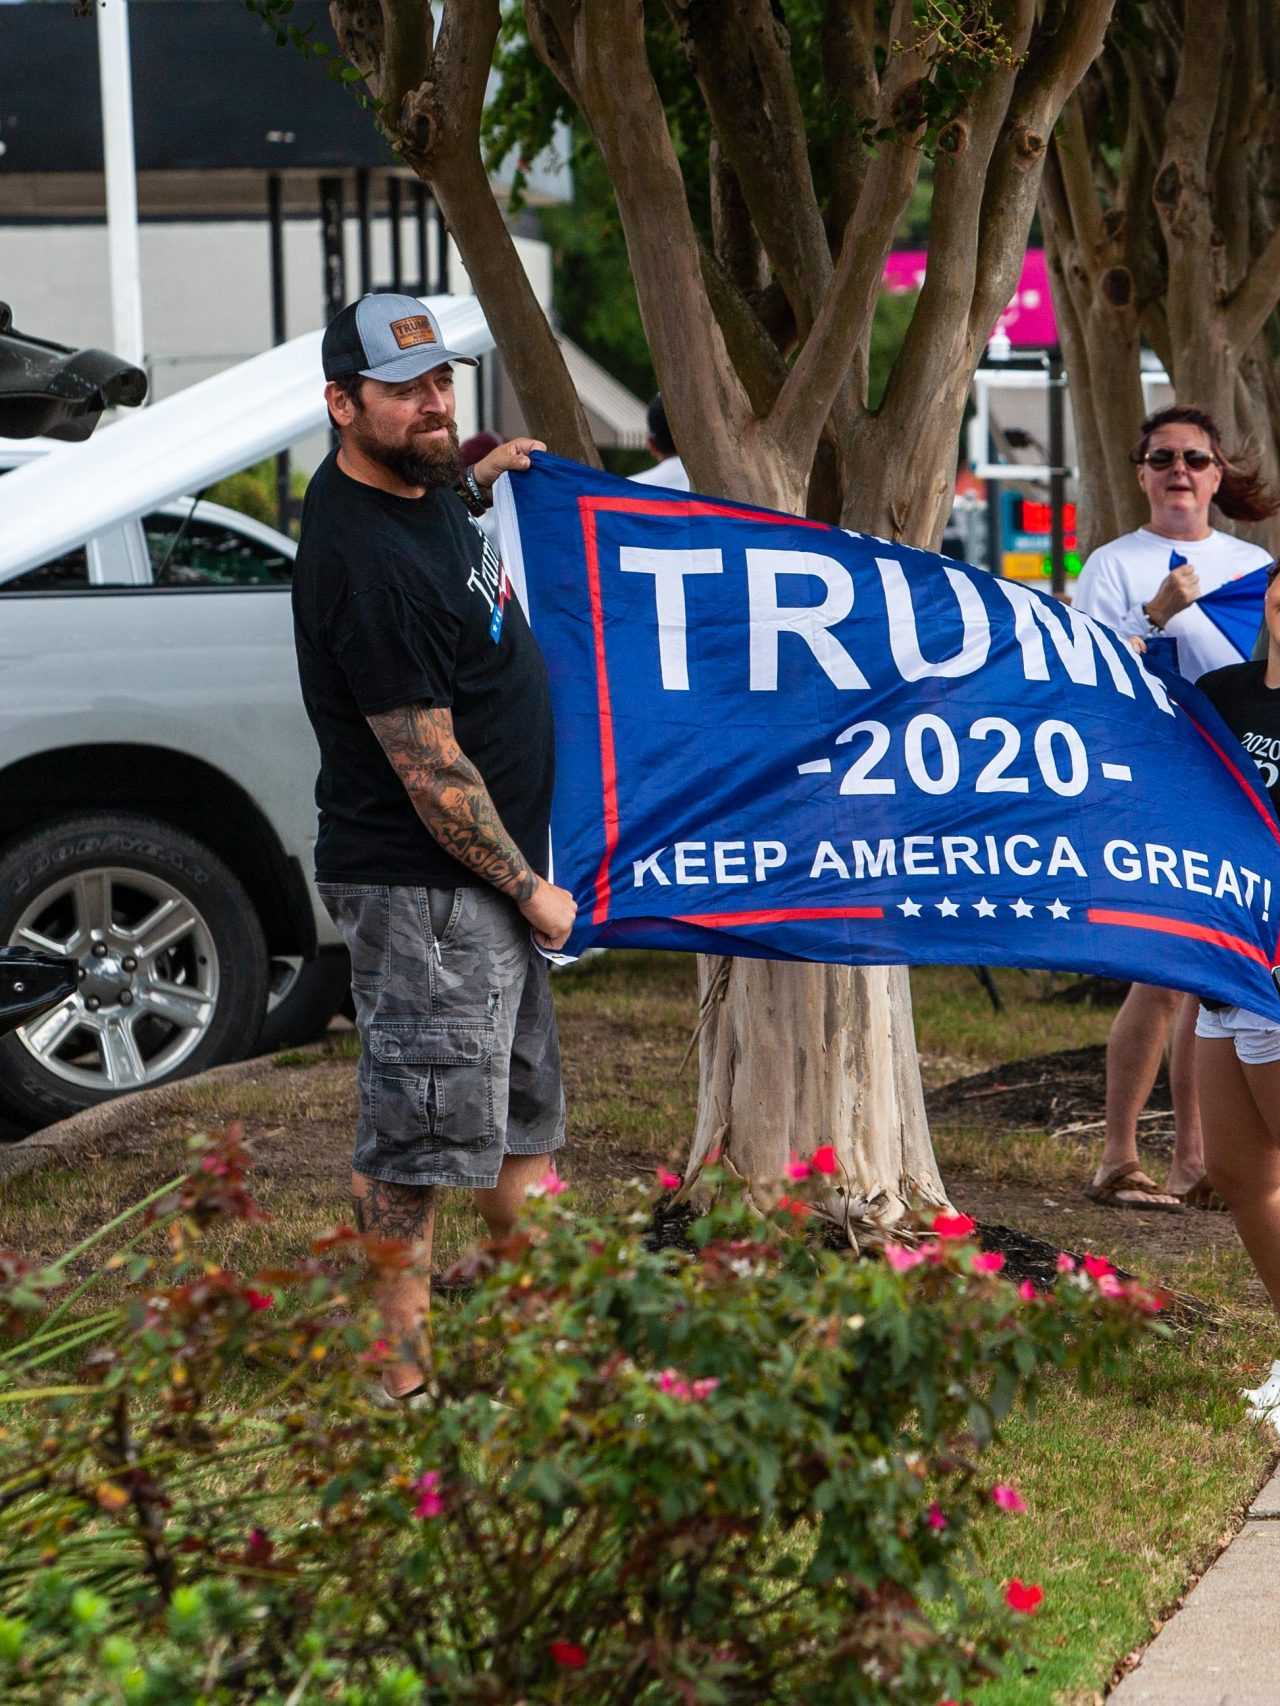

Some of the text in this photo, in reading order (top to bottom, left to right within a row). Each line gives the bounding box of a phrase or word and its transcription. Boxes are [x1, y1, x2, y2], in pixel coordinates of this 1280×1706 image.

[632, 834, 1272, 922] KEEP AMERICA GREAT!
